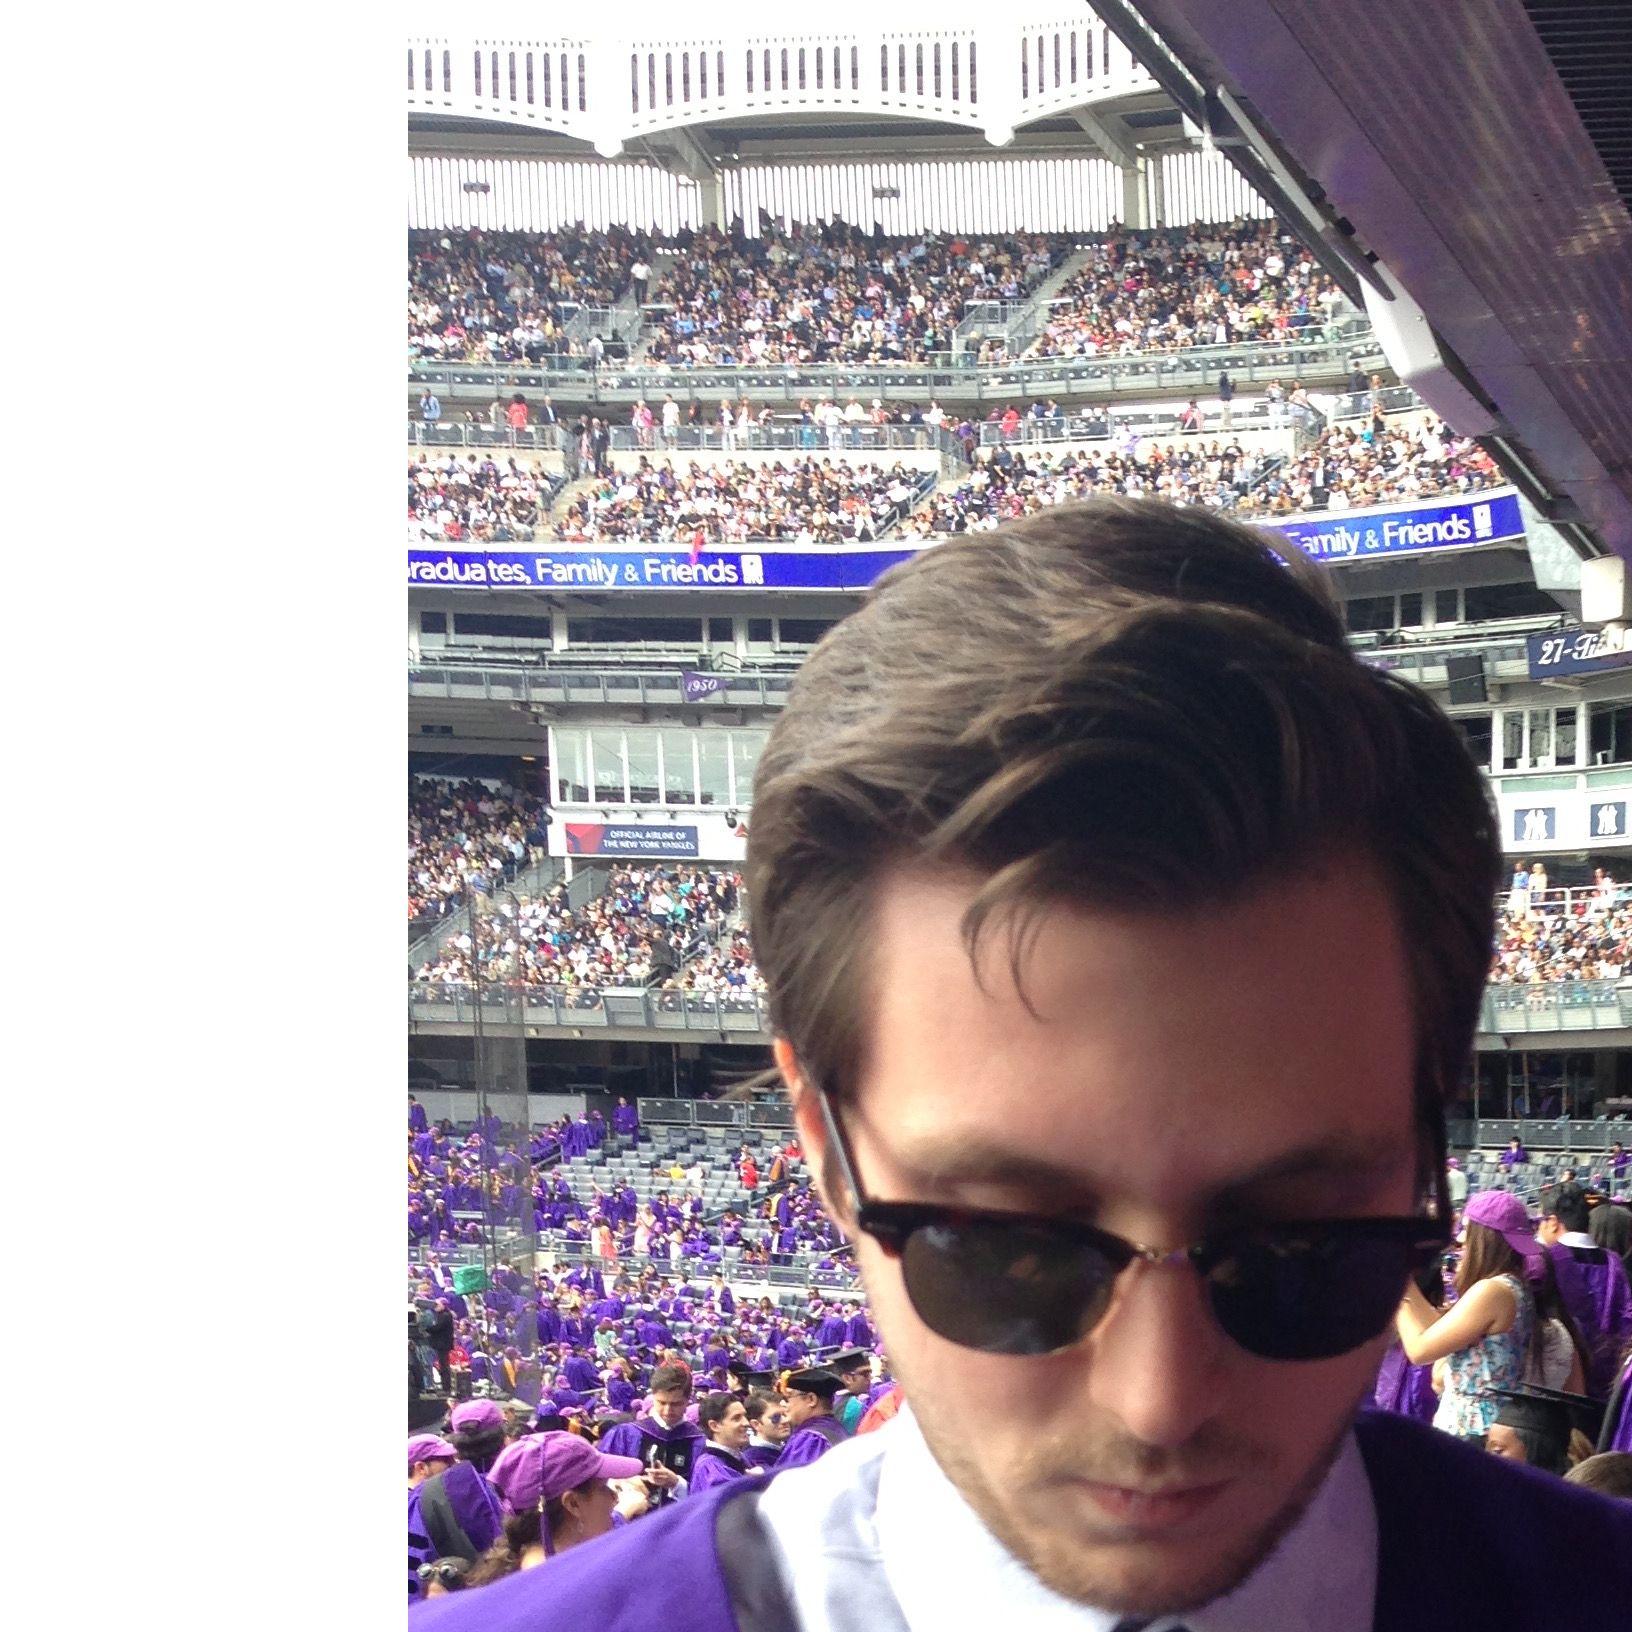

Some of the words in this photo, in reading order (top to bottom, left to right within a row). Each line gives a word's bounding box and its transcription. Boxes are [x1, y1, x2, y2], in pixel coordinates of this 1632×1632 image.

[1365, 531, 1379, 548] &
[1382, 514, 1472, 547] Friends
[408, 557, 531, 585] raduates,
[535, 558, 618, 586] Family
[624, 562, 640, 582] &
[644, 559, 738, 583] Friends
[687, 679, 717, 692] 1950
